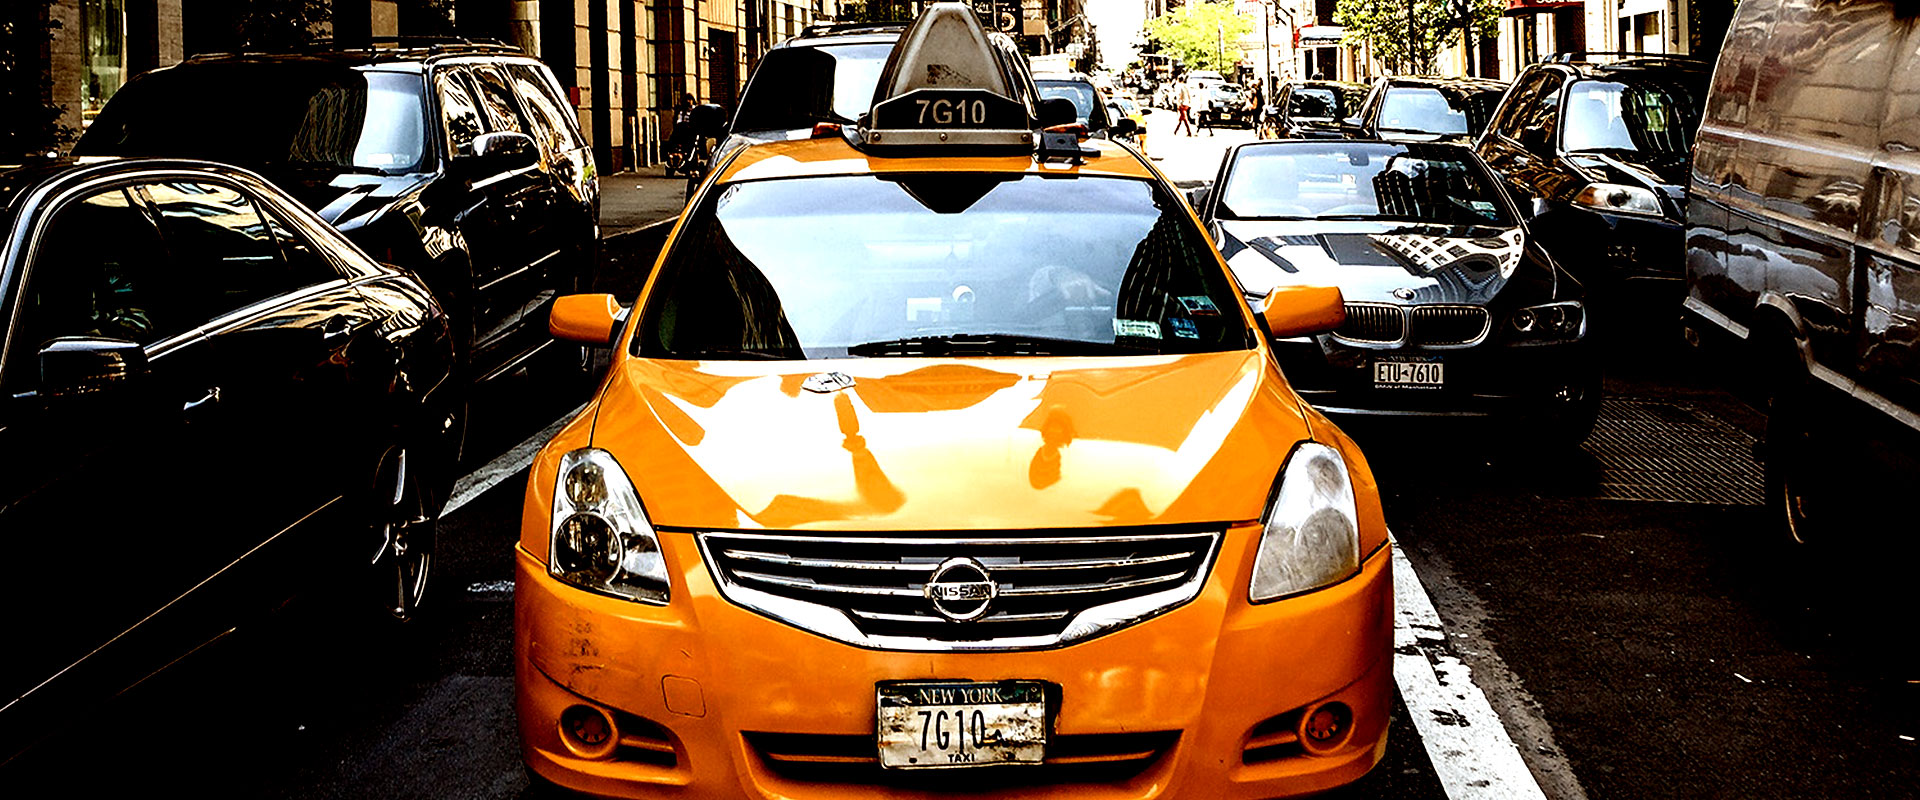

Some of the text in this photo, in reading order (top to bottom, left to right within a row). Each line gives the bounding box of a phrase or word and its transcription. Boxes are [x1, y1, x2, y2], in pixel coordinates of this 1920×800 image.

[916, 99, 986, 124] 7G10
[931, 584, 992, 598] NISSAN
[919, 686, 1003, 705] NEW YORK
[917, 709, 985, 752] 7G10
[947, 753, 975, 764] TAXI
